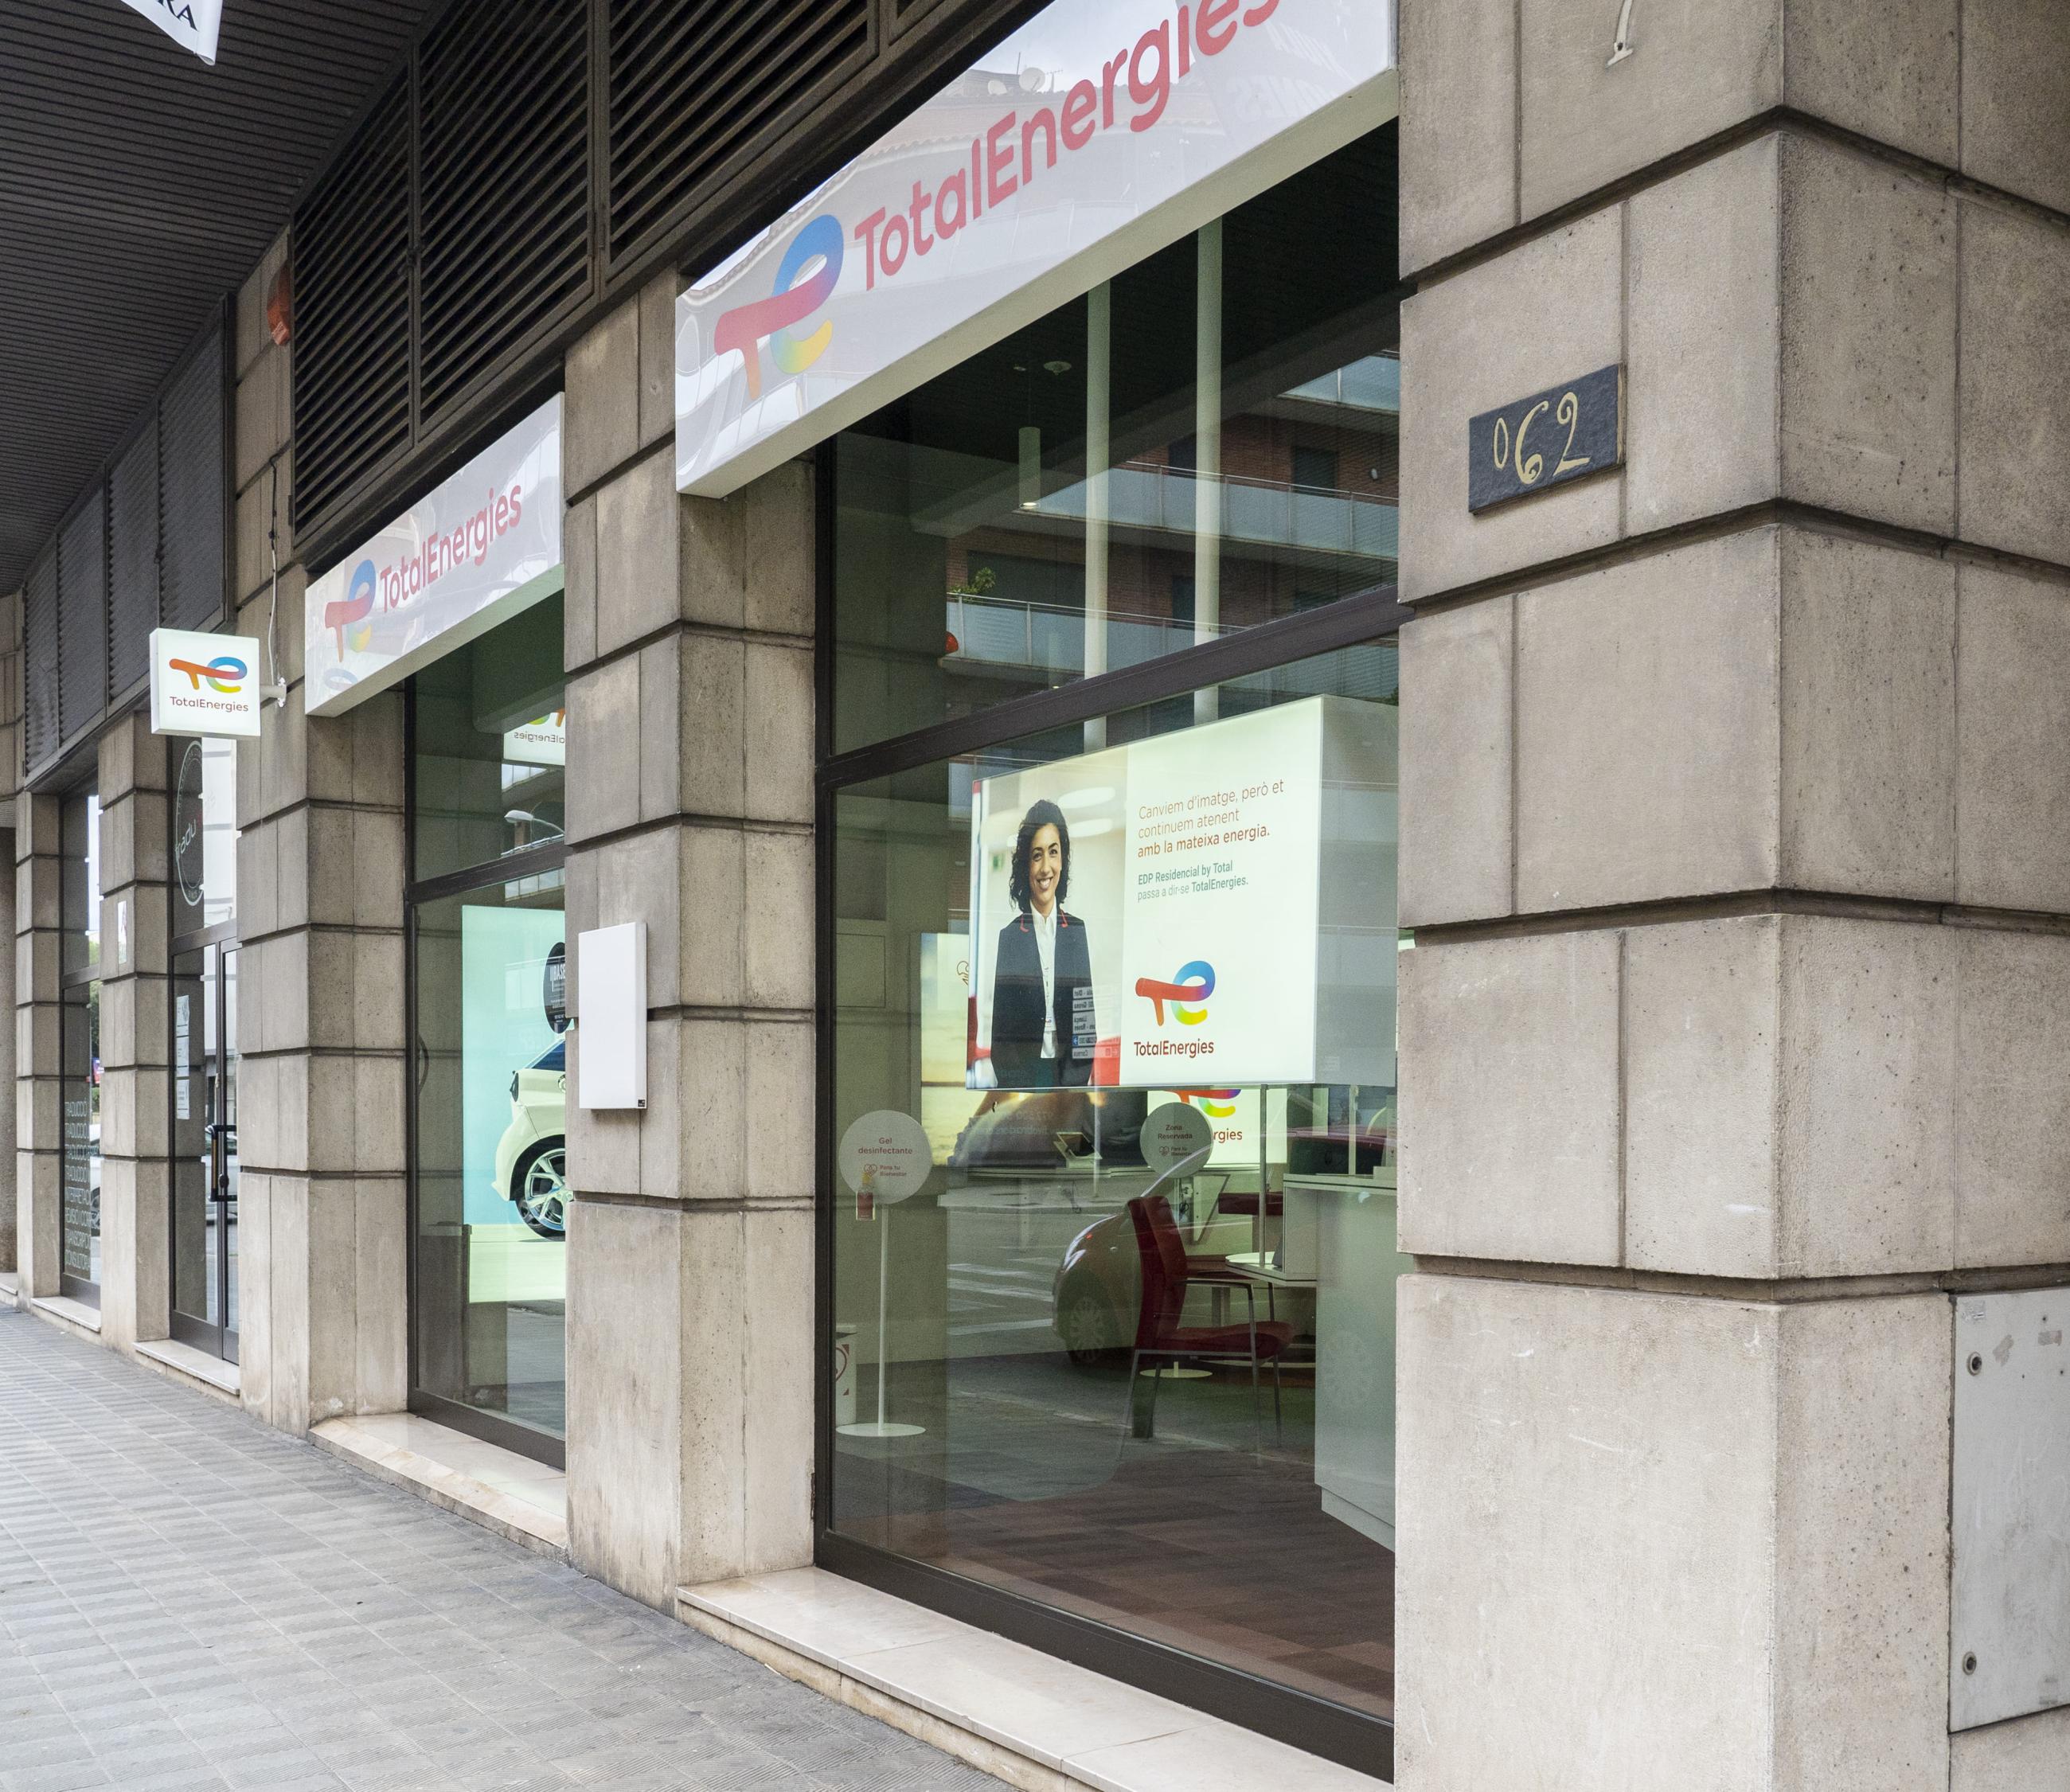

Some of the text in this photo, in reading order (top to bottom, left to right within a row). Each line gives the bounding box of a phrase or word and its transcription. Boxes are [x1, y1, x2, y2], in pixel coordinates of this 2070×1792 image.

[854, 0, 1279, 291] TotalEnergie
[1494, 392, 1592, 485] 062
[380, 485, 521, 613] TotalEnergies
[169, 696, 249, 713] TotalEnergies
[1138, 802, 1184, 819] Canviem
[1242, 781, 1268, 802] però
[1272, 779, 1284, 794] et
[1138, 808, 1240, 839] continuem atenent
[1138, 823, 1270, 857] amb la mateixa energia.
[1138, 860, 1233, 885] EDP Residencial by Total
[1138, 875, 1248, 904] passa a dir-se TotalEnergies.
[1133, 1037, 1214, 1058] TotalEnergies
